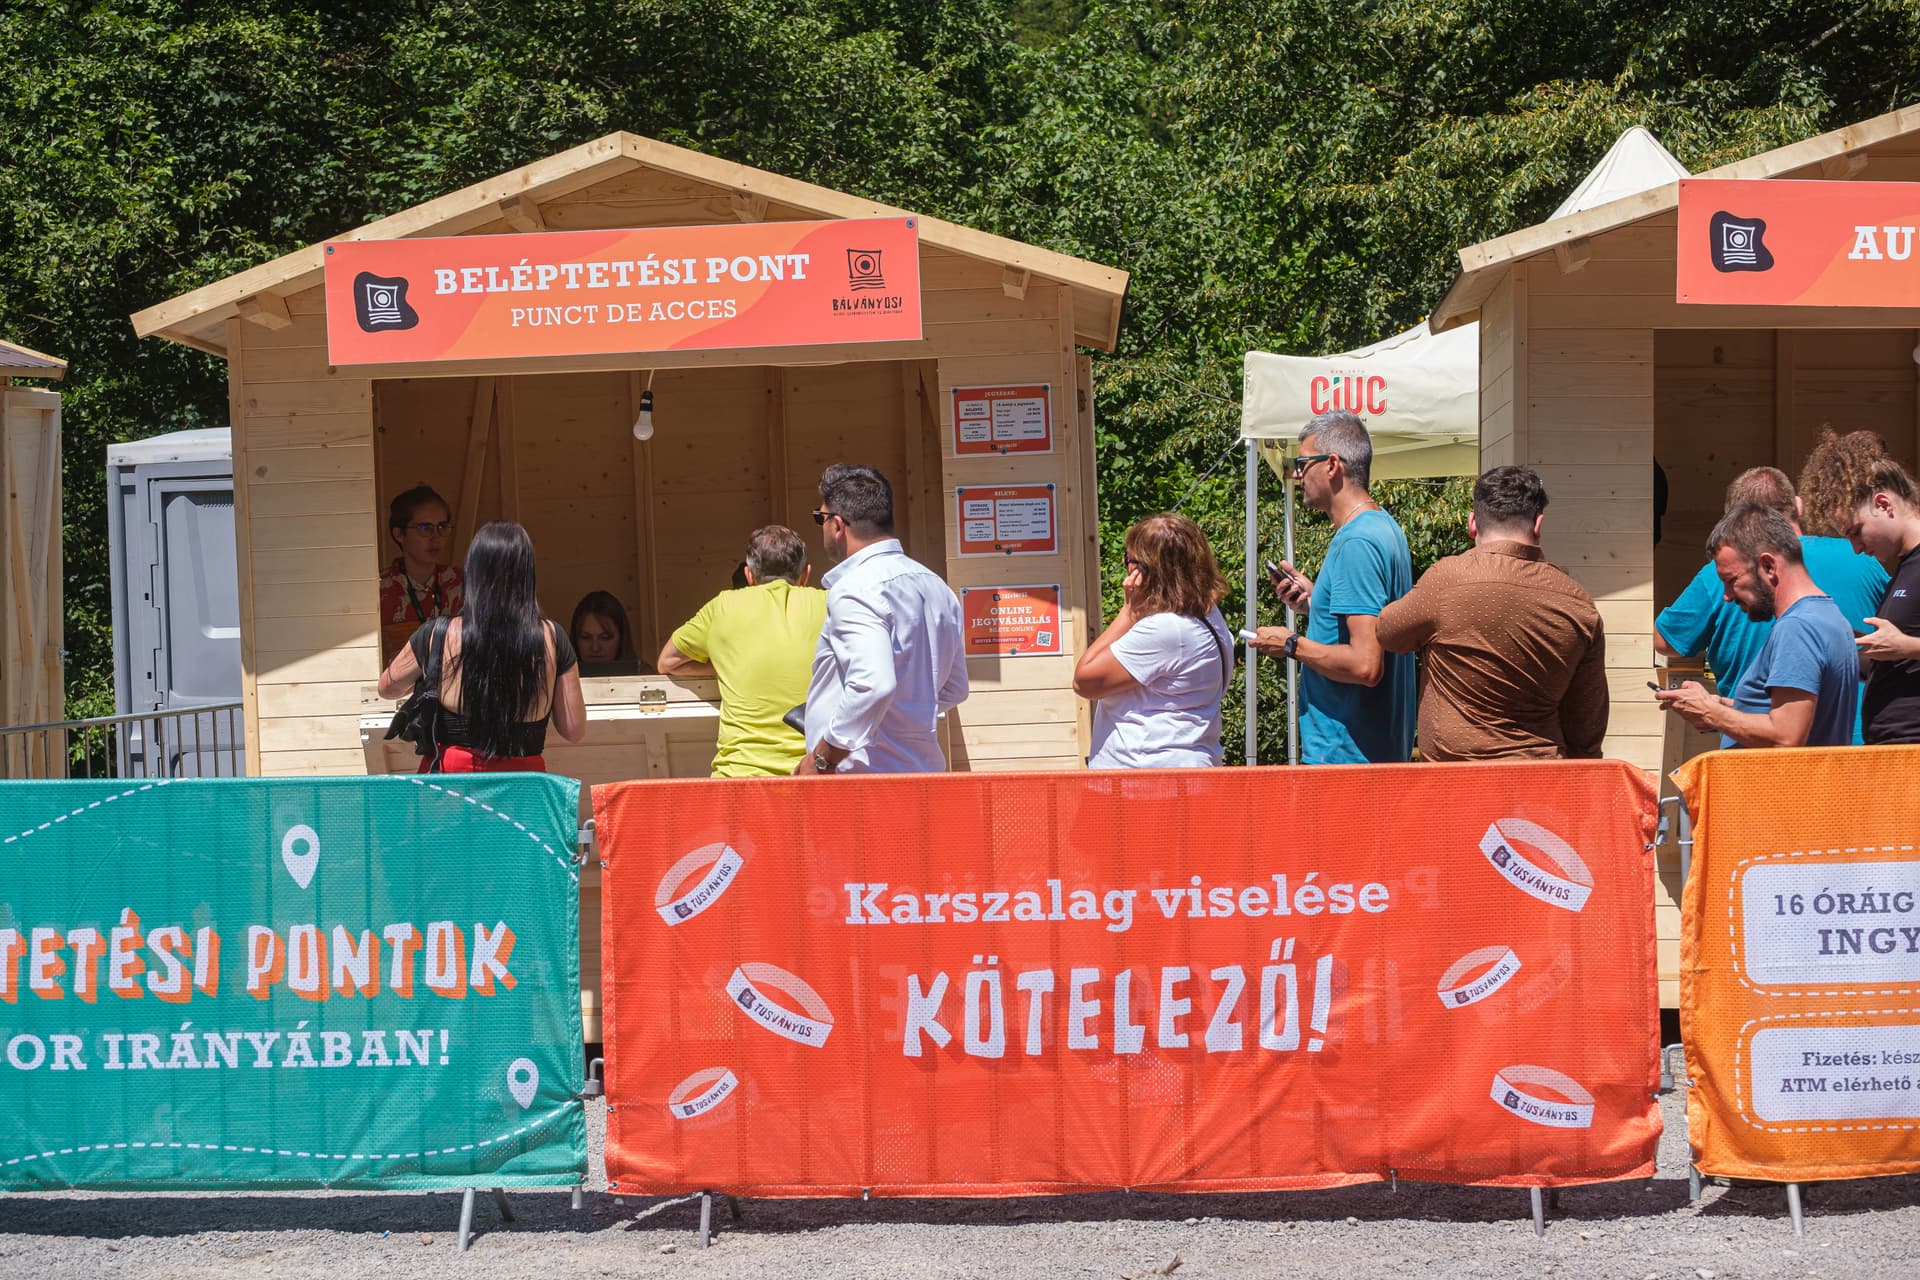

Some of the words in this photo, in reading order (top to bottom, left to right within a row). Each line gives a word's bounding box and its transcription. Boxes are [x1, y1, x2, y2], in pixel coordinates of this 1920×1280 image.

[1848, 226, 1920, 260] AU
[434, 253, 697, 295] BELÉPTETÉSI
[705, 254, 810, 283] PONT
[511, 305, 598, 327] PUNCT
[606, 303, 642, 323] DE
[648, 300, 737, 321] ACCES
[971, 614, 1052, 629] JEGYVÁSÁRLÁS
[990, 606, 1033, 615] ONLINE
[843, 879, 1137, 932] Karszalag
[1151, 872, 1390, 918] viselése
[1774, 894, 1805, 916] 16
[1813, 887, 1915, 915] ÓRÁIG
[1817, 927, 1920, 955] INGY
[246, 920, 519, 1003] PONTOK
[902, 936, 1334, 1058] KÖTELEZŐ!
[0, 1034, 88, 1071] OR
[103, 1021, 449, 1070] IRÁNYÁBAN!
[1801, 1052, 1877, 1067] Fizetés:
[1780, 1078, 1827, 1093] ATM
[1832, 1075, 1912, 1092] elérhető
